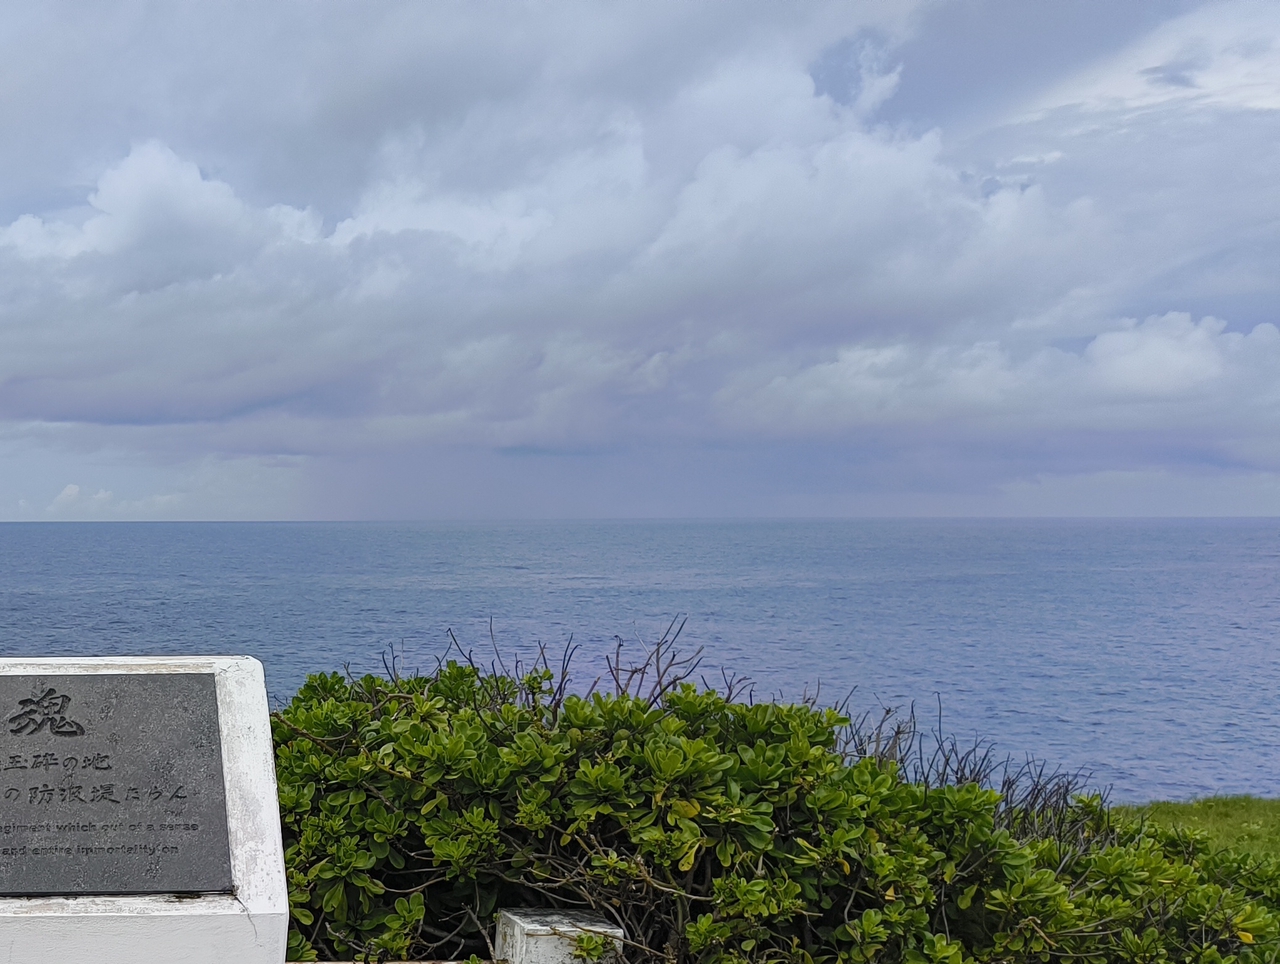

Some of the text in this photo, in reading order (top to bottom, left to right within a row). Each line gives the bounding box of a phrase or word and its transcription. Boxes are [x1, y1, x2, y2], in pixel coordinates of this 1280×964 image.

[56, 822, 96, 832] which
[101, 822, 122, 832] out
[128, 822, 143, 832] of
[147, 824, 155, 832] a
[160, 823, 199, 831] sense
[2, 845, 27, 855] and
[32, 845, 72, 855] entire
[77, 844, 156, 856] immortality
